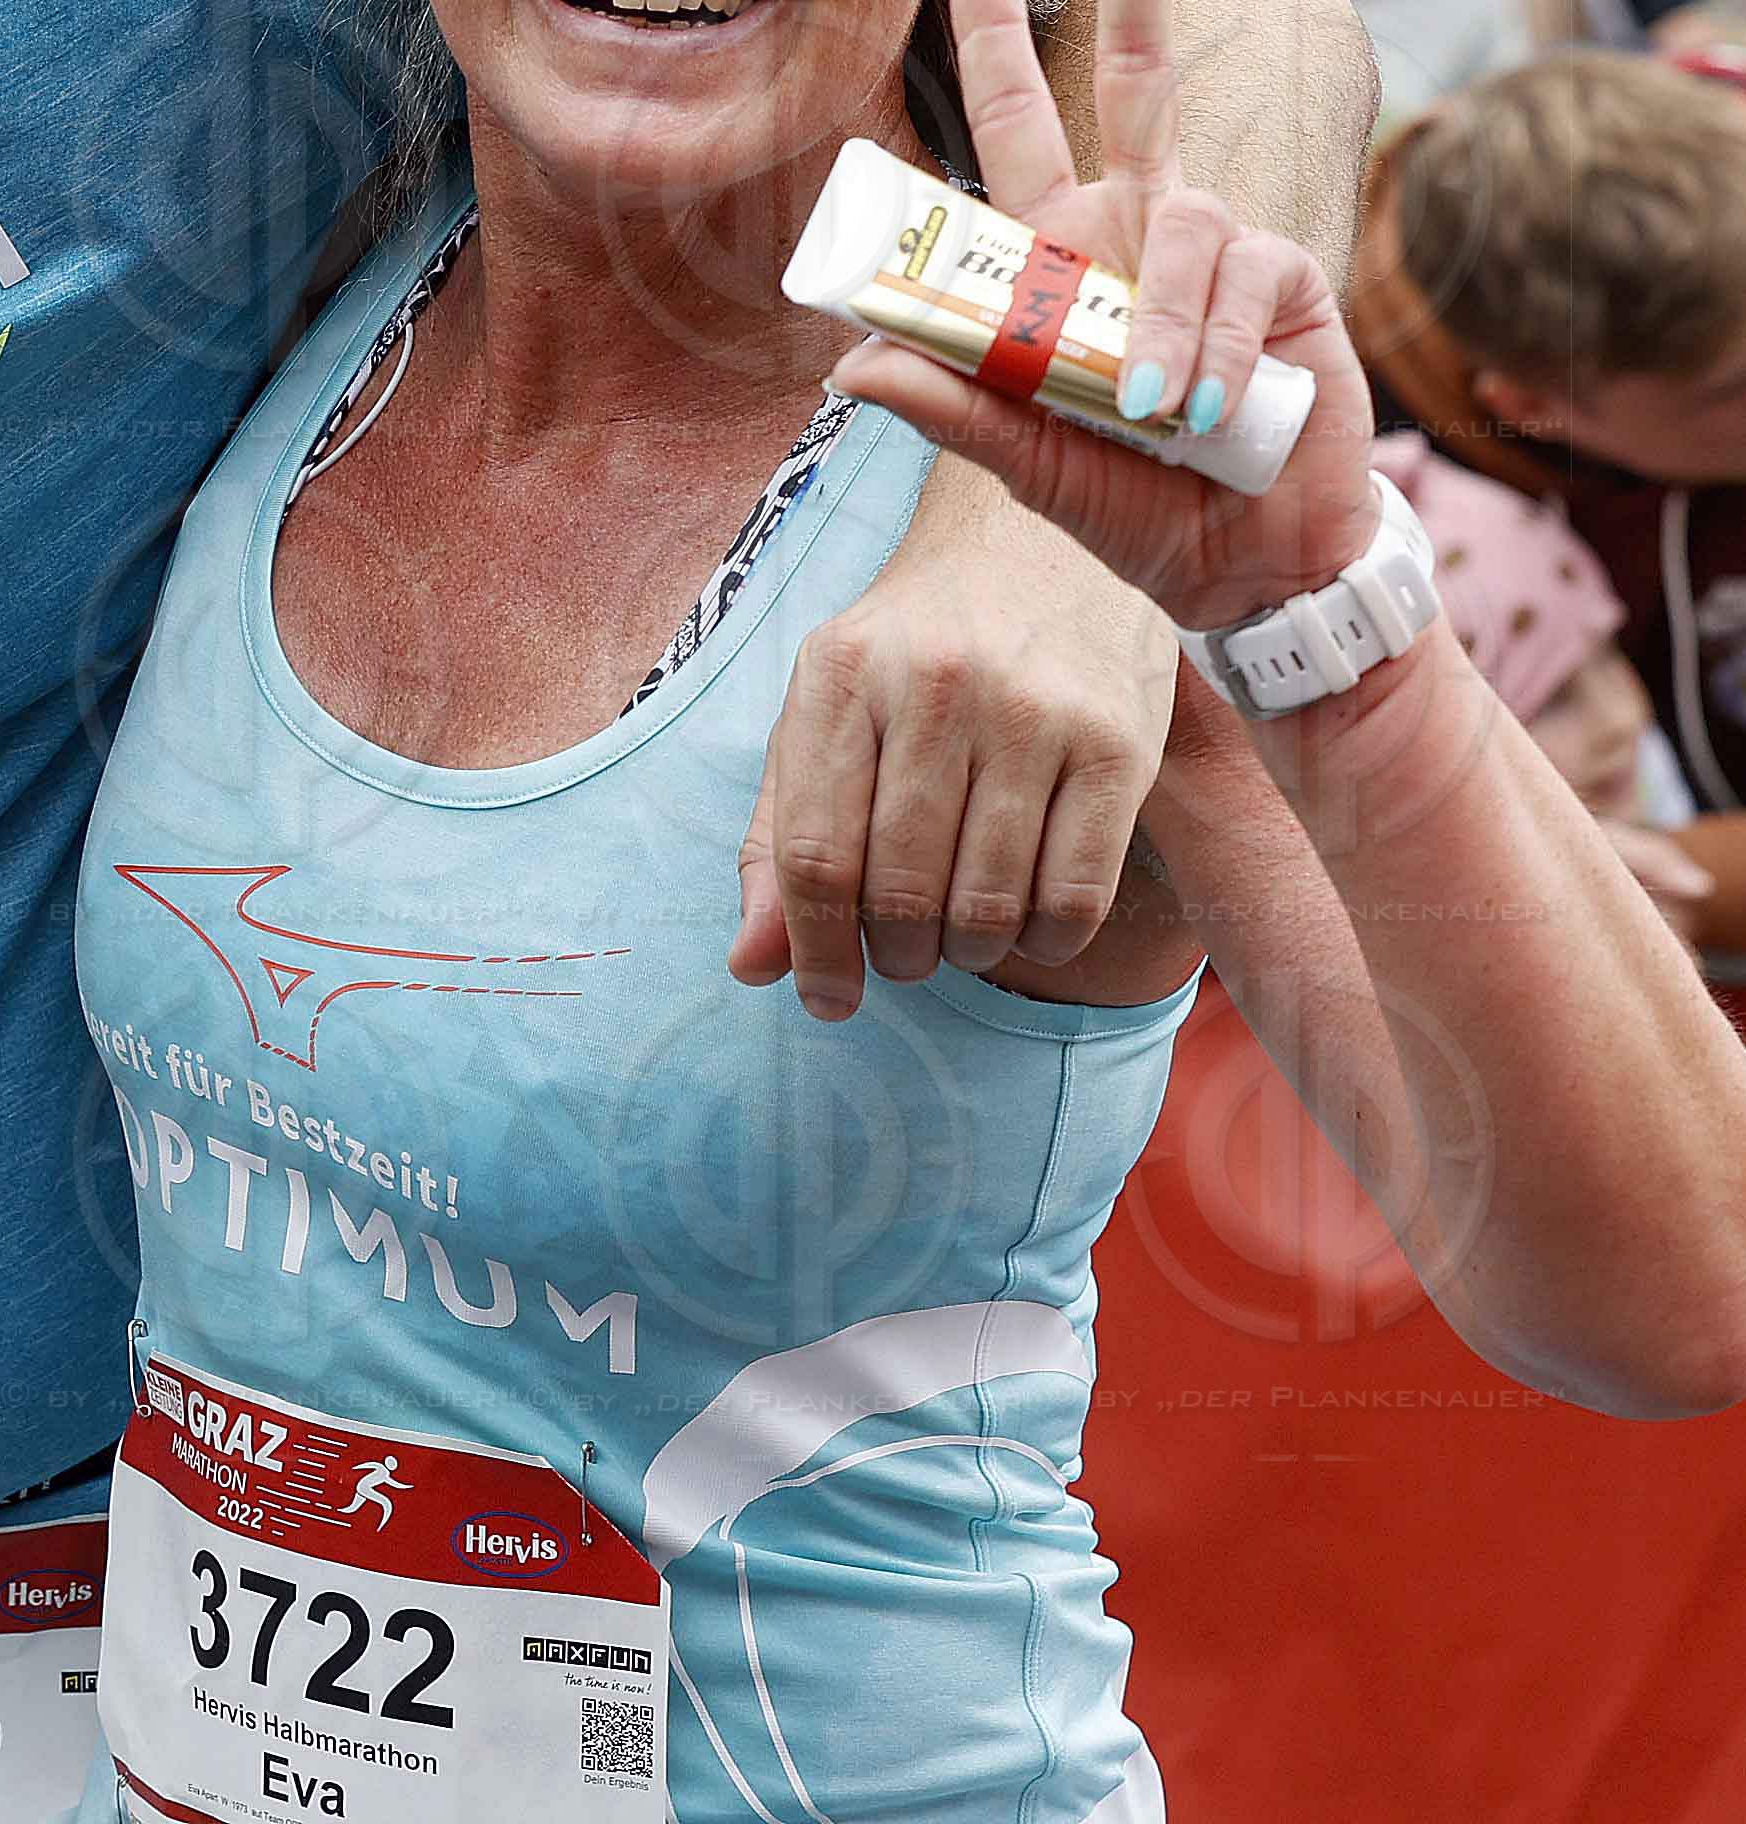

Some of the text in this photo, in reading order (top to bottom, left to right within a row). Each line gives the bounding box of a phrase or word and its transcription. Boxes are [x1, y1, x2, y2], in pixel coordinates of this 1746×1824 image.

[89, 1013, 461, 1220] ereit für Bestzeit!
[171, 1431, 248, 1496] MARATHON
[187, 1390, 290, 1474] GRAZ
[216, 1495, 266, 1531] 2022
[464, 1523, 560, 1565] Hervis
[7, 1583, 94, 1610] Hervis
[188, 1547, 456, 1729] 3722
[192, 1686, 439, 1776] Hervis Halbmarathon
[262, 1751, 346, 1819] Eva
[583, 1773, 607, 1786] Dein
